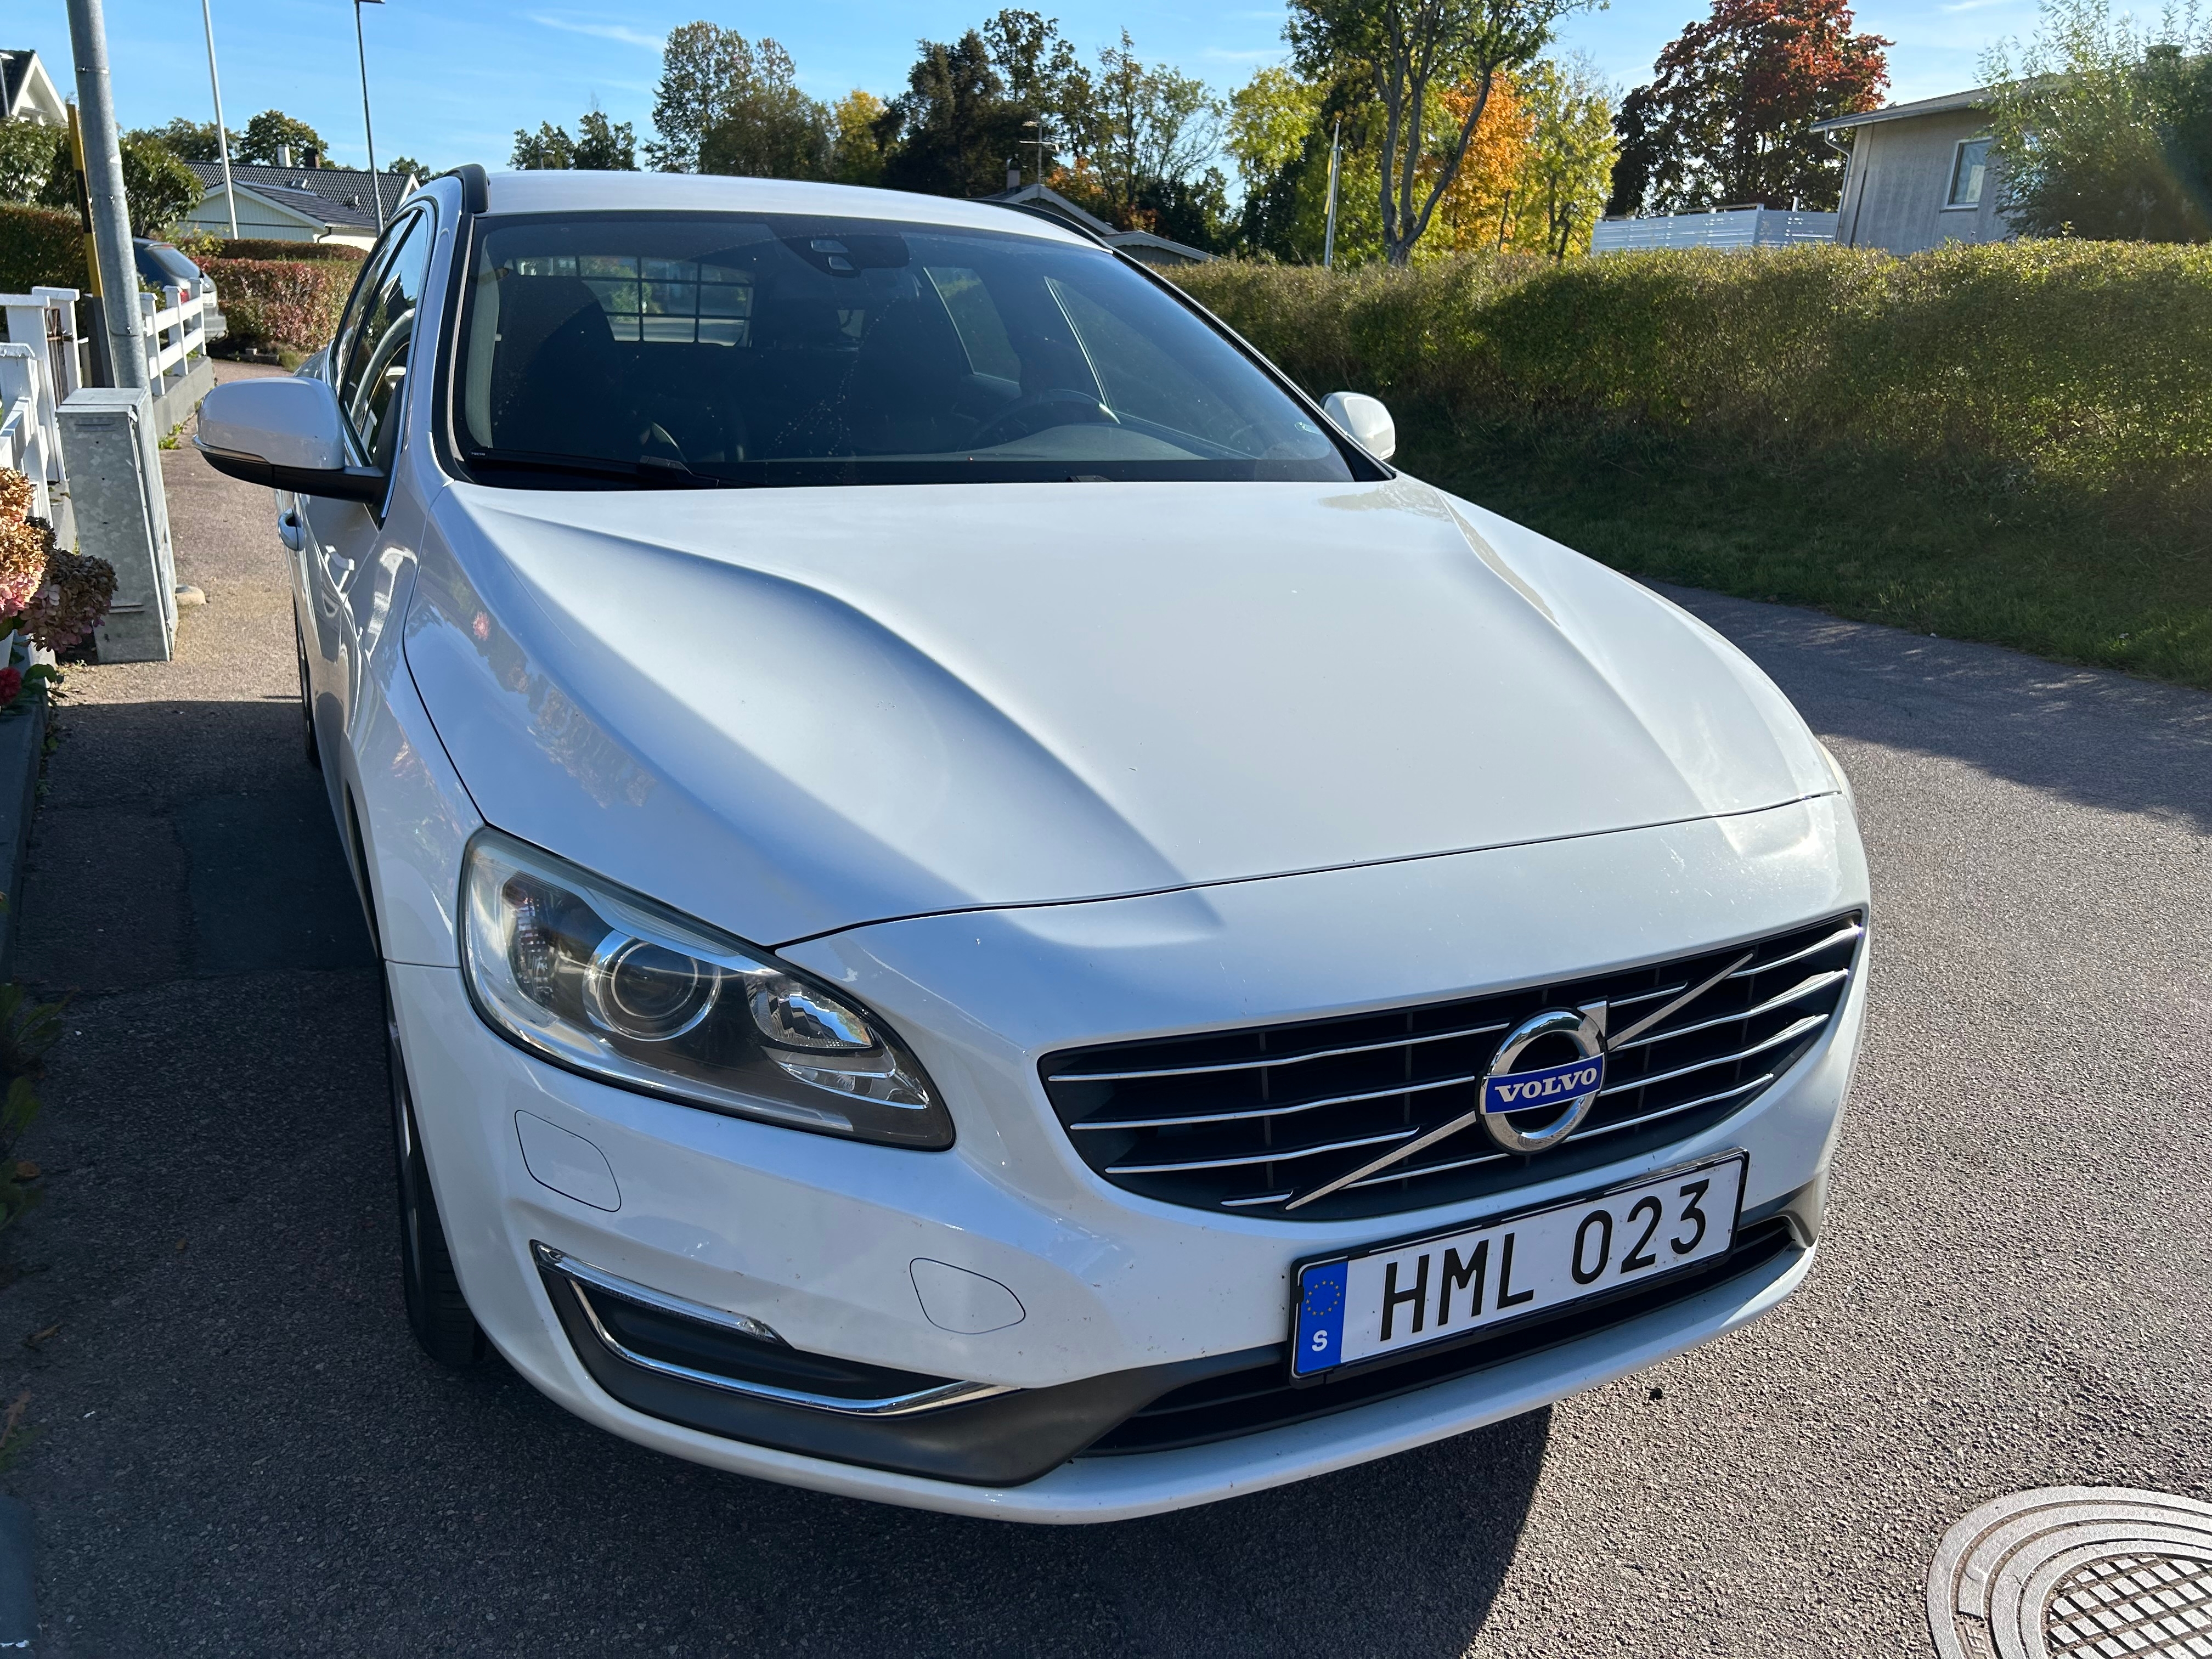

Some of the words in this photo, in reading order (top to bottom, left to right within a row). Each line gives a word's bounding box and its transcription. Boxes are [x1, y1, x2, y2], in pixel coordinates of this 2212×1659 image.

[1494, 1068, 1598, 1102] VOLVO
[1380, 1232, 1534, 1342] HML
[1571, 1178, 1710, 1285] 023
[1312, 1329, 1328, 1352] S
